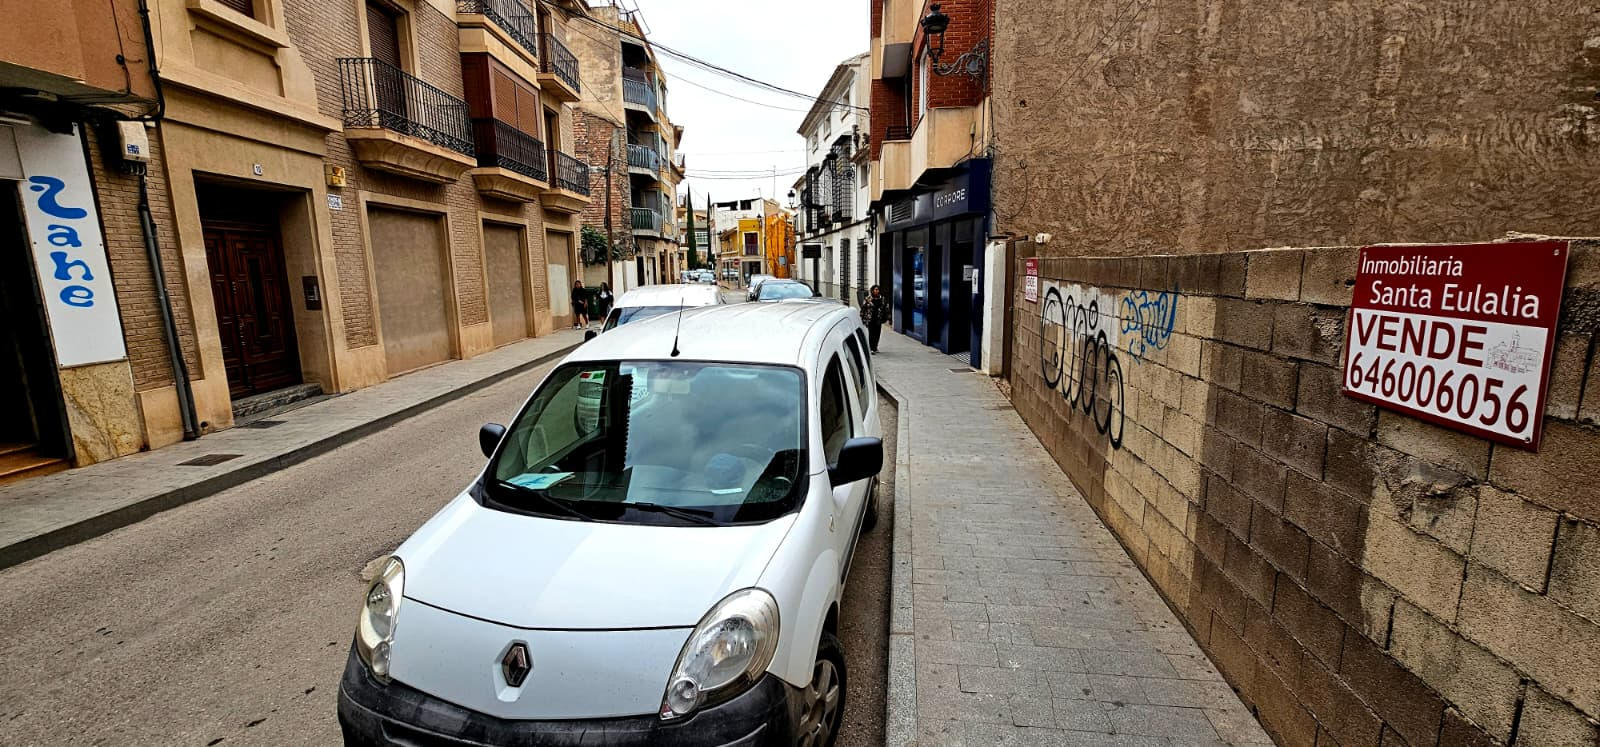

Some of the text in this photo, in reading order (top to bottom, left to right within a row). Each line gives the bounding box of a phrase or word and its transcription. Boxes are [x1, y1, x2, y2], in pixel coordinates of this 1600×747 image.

[936, 188, 966, 208] CORPORE
[1361, 254, 1463, 276] Inmobiliaria
[1369, 280, 1539, 319] Santa Eulalia
[1356, 312, 1488, 368] VENDE
[1350, 352, 1529, 434] 646006056
